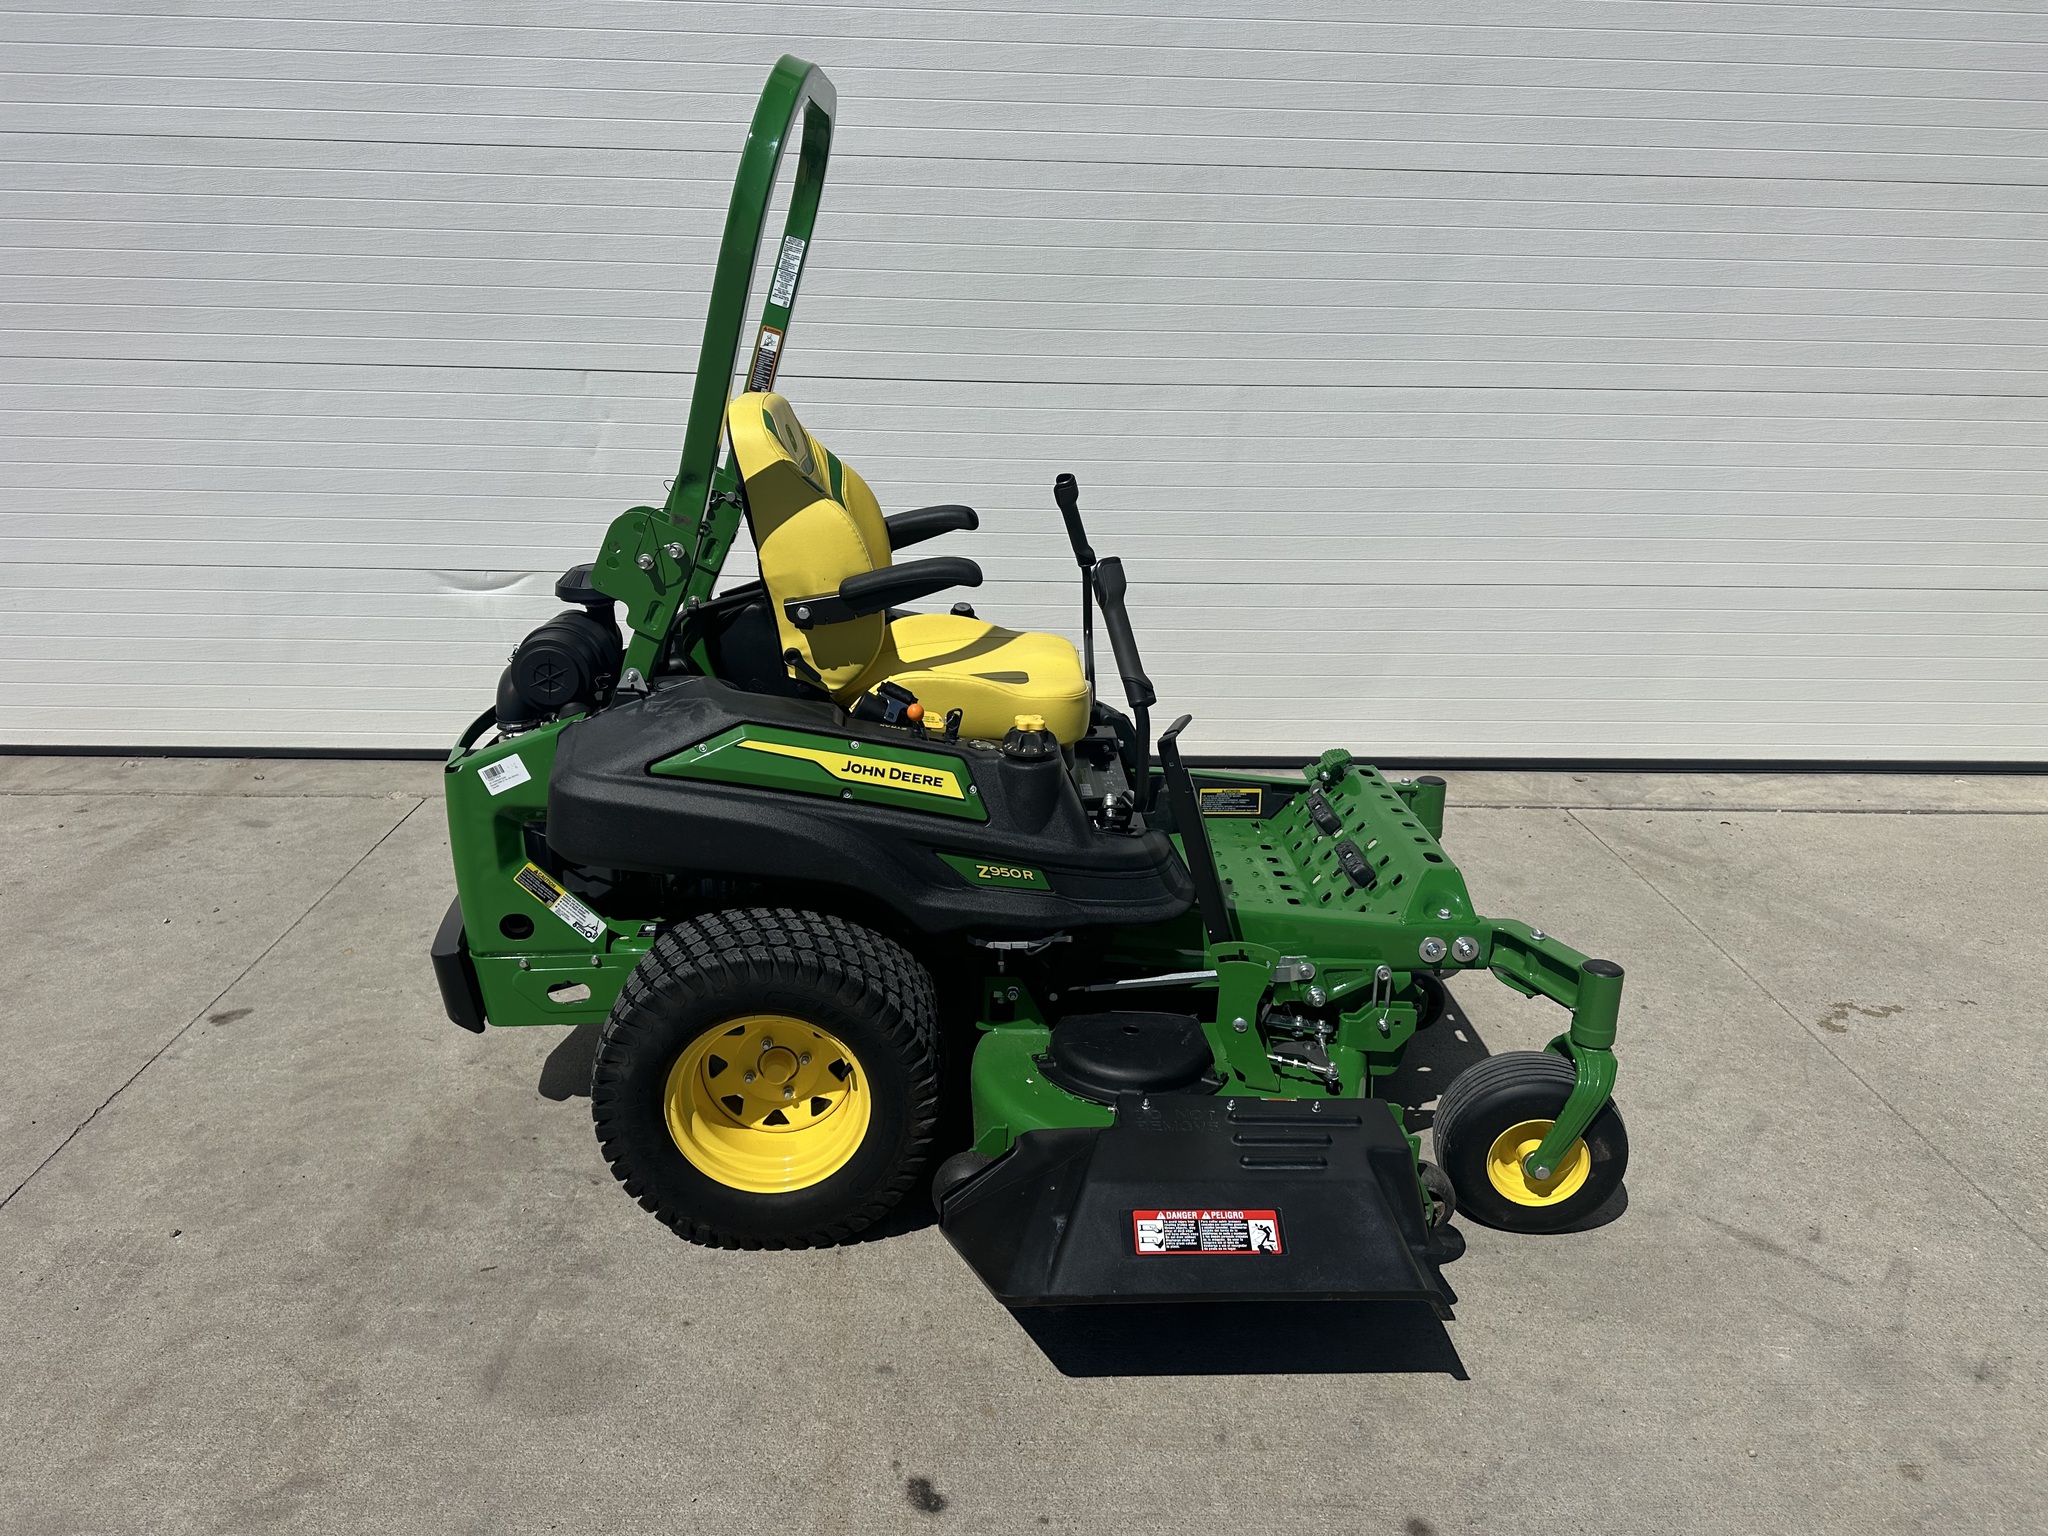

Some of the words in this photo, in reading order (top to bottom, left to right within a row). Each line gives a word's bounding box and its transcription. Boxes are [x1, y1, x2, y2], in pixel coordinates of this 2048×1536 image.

[841, 760, 885, 777] JOHN
[889, 769, 943, 787] DEERE
[976, 864, 1034, 881] Z950R
[538, 872, 557, 888] CAUTION
[1134, 1109, 1161, 1120] DO
[1175, 1109, 1216, 1121] NOT
[1136, 1120, 1221, 1132] REMOVE
[1166, 1211, 1198, 1219] DANGER
[1211, 1211, 1244, 1219] PELIGRO
